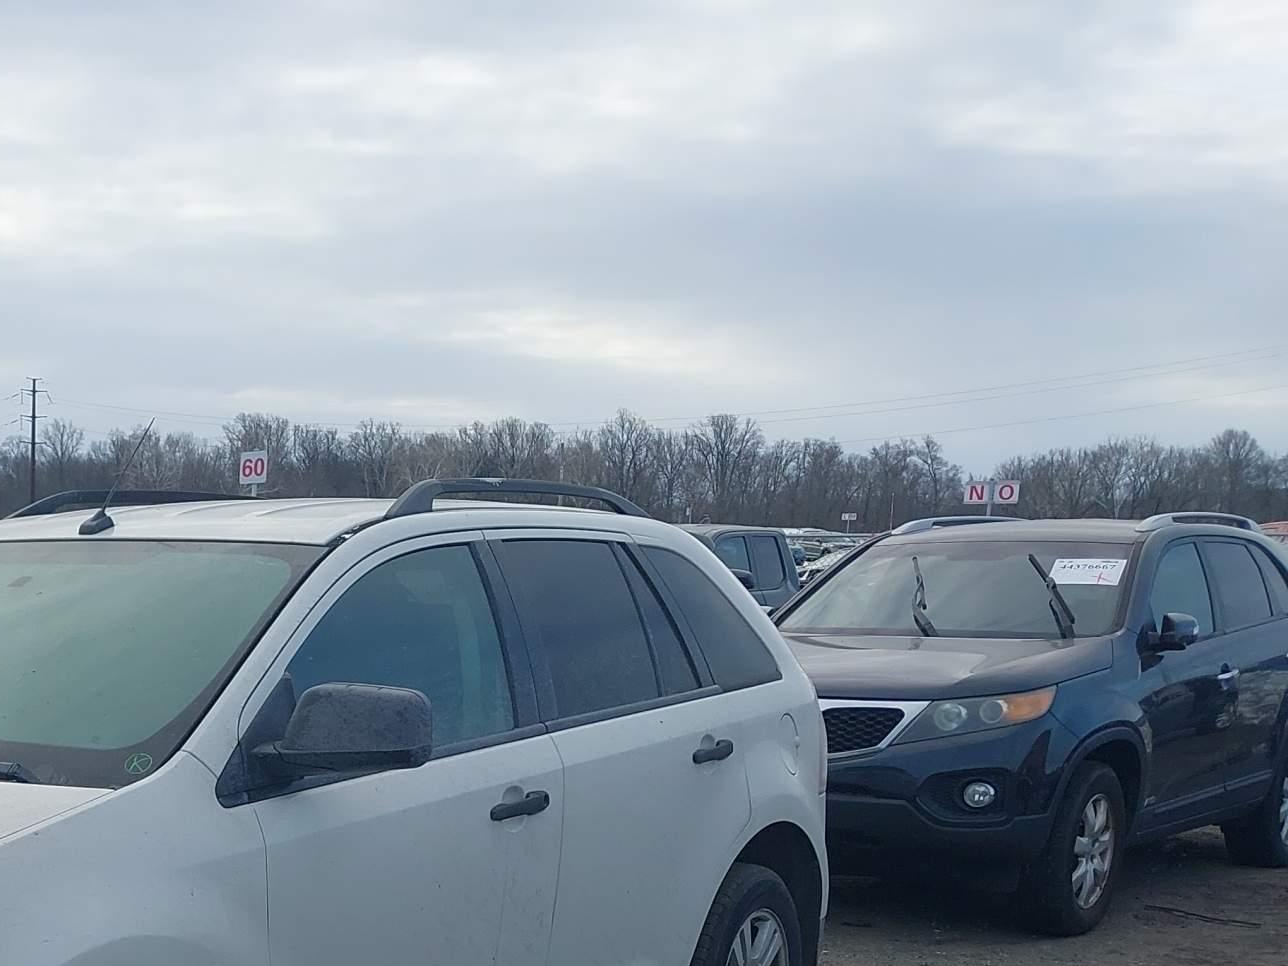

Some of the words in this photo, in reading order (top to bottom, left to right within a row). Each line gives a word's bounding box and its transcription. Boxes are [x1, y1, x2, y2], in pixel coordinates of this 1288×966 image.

[242, 458, 265, 477] 60
[969, 485, 985, 501] N
[998, 484, 1015, 501] O
